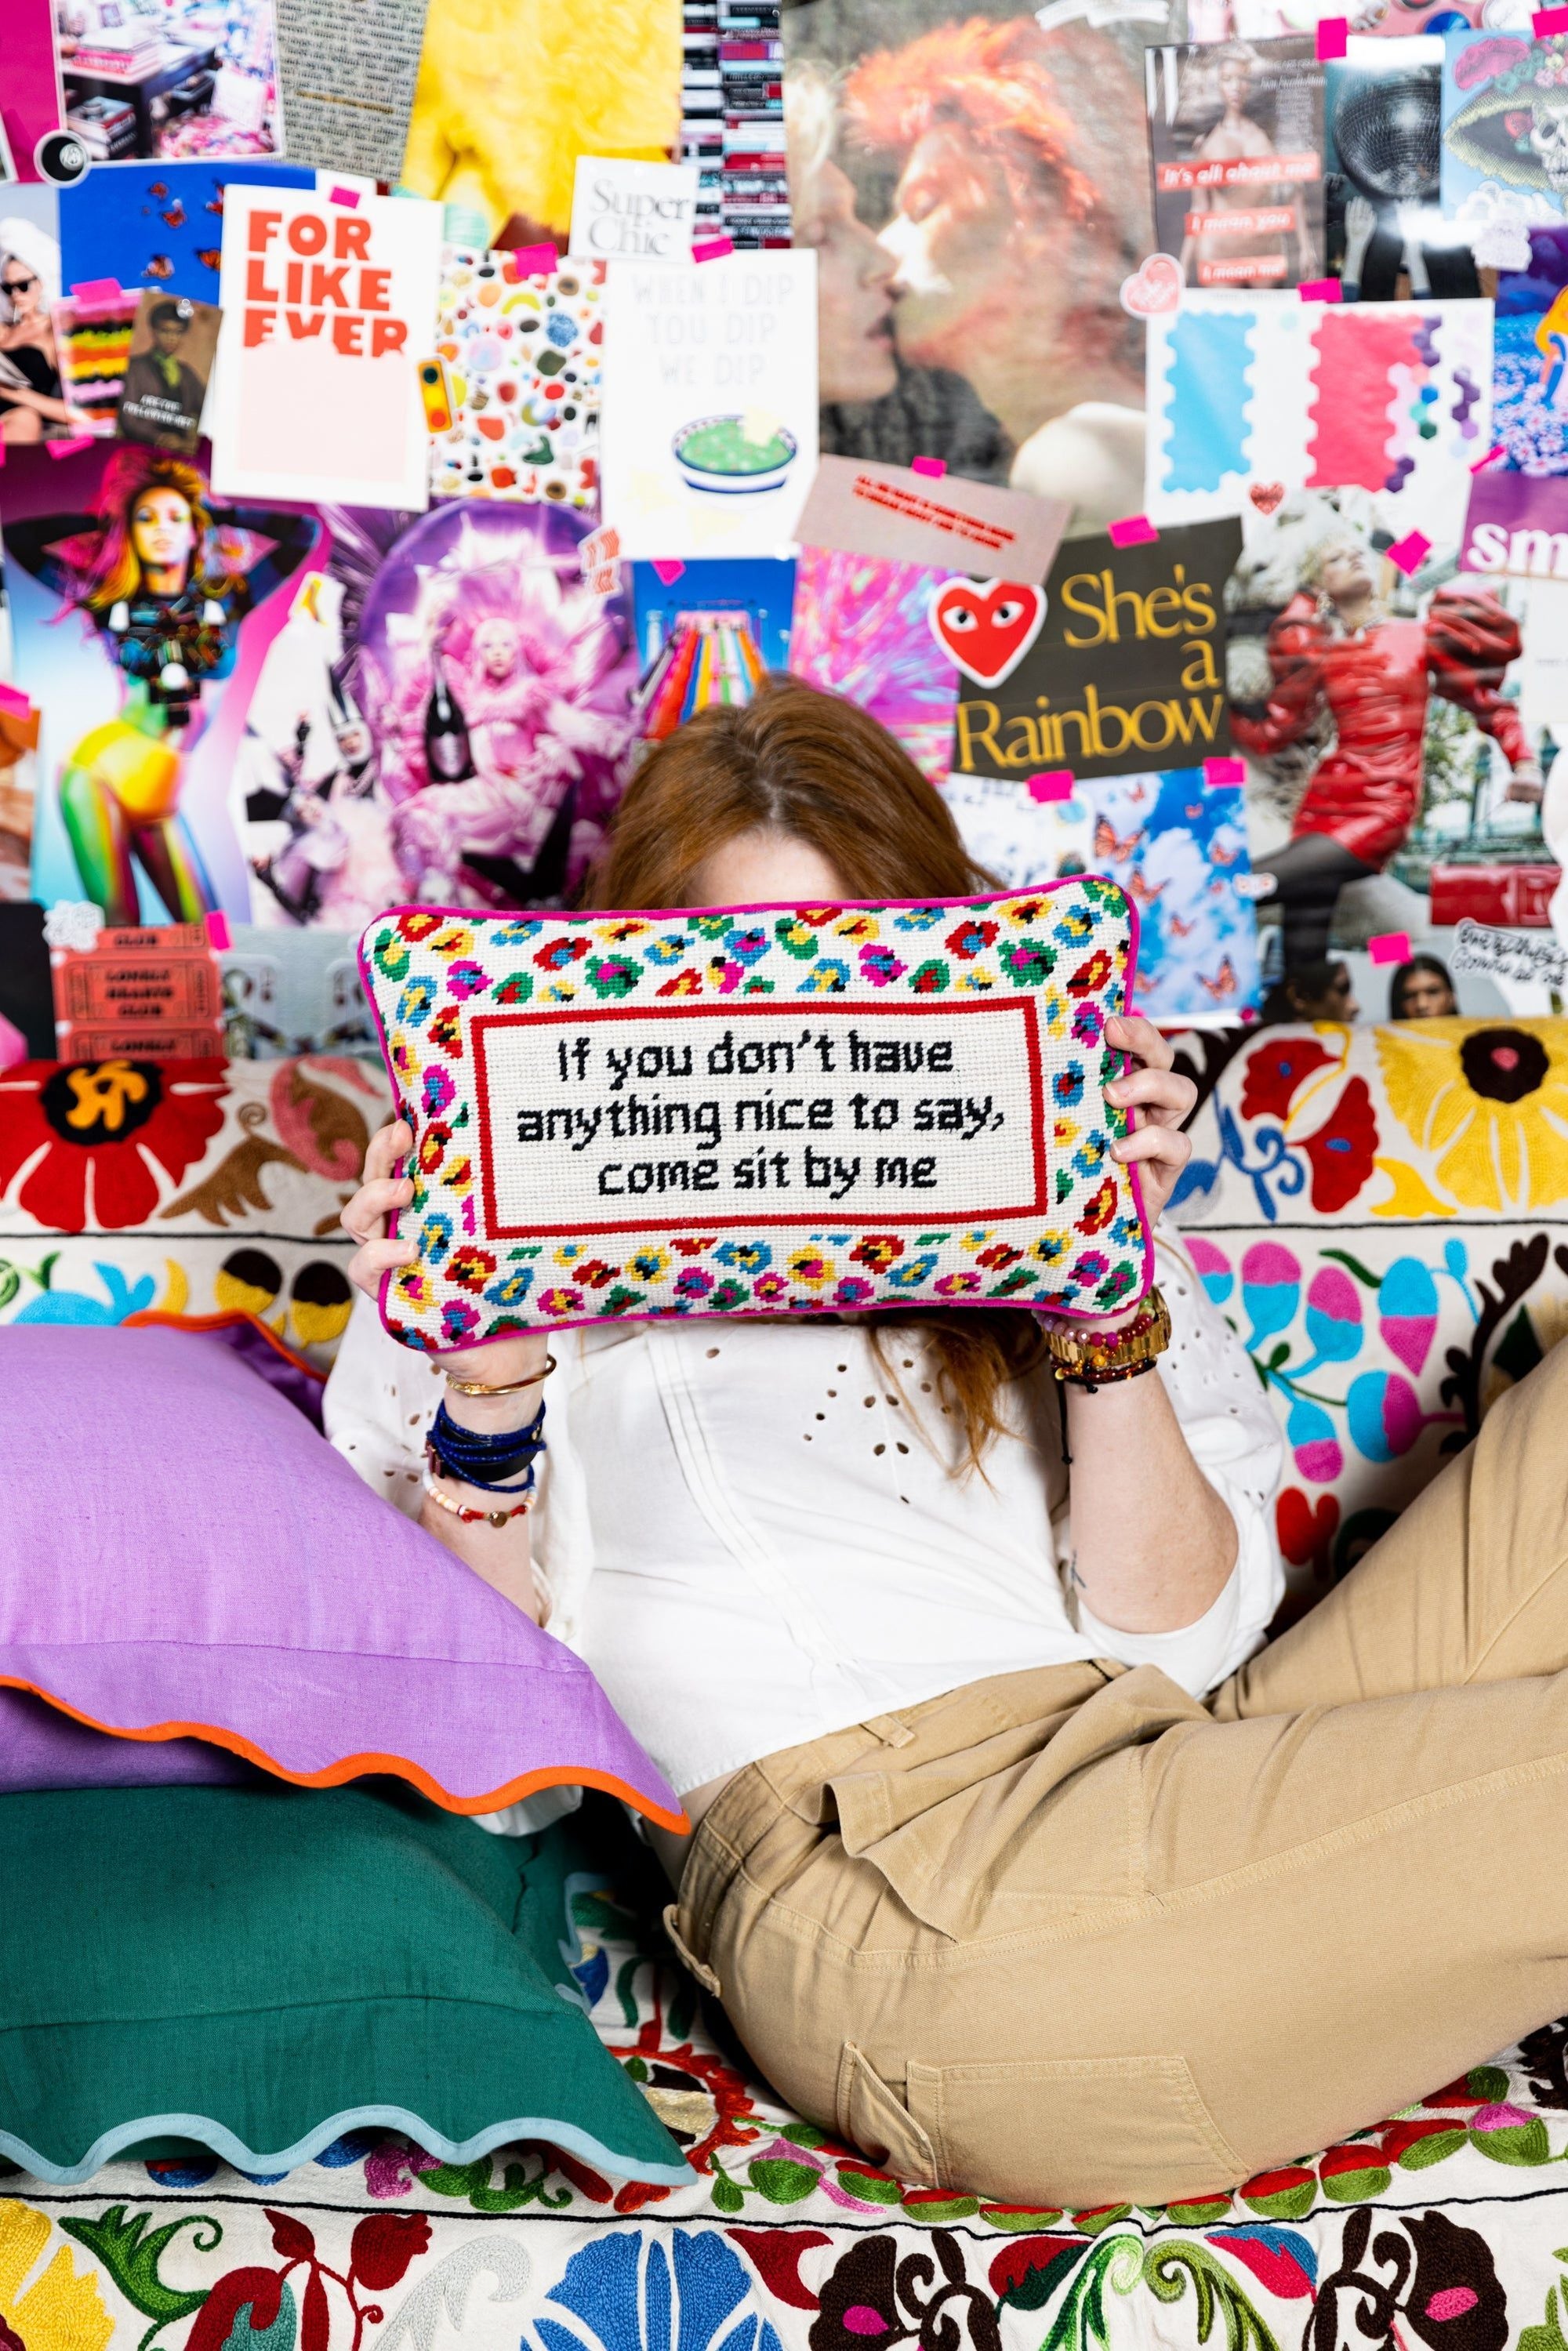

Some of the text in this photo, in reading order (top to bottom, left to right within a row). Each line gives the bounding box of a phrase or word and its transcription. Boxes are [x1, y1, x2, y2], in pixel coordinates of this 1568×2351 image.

[1164, 161, 1313, 185] It's all about me
[592, 179, 690, 227] Super
[1192, 212, 1291, 231] I mean you
[248, 210, 372, 261] FOR
[589, 216, 670, 255] Chic
[246, 259, 391, 311] LIKE
[632, 273, 705, 304] WHEN
[745, 273, 794, 305] DIP
[1213, 265, 1256, 279] mean
[646, 312, 776, 345] YOU DIP
[660, 351, 765, 386] WE DIP
[1061, 564, 1217, 648] She's
[1180, 640, 1221, 691] a
[958, 684, 1224, 772] Rainbow
[557, 1029, 954, 1090] If you don't have
[517, 1088, 1004, 1151] anything nice to say,
[597, 1145, 938, 1200] come sit by me
